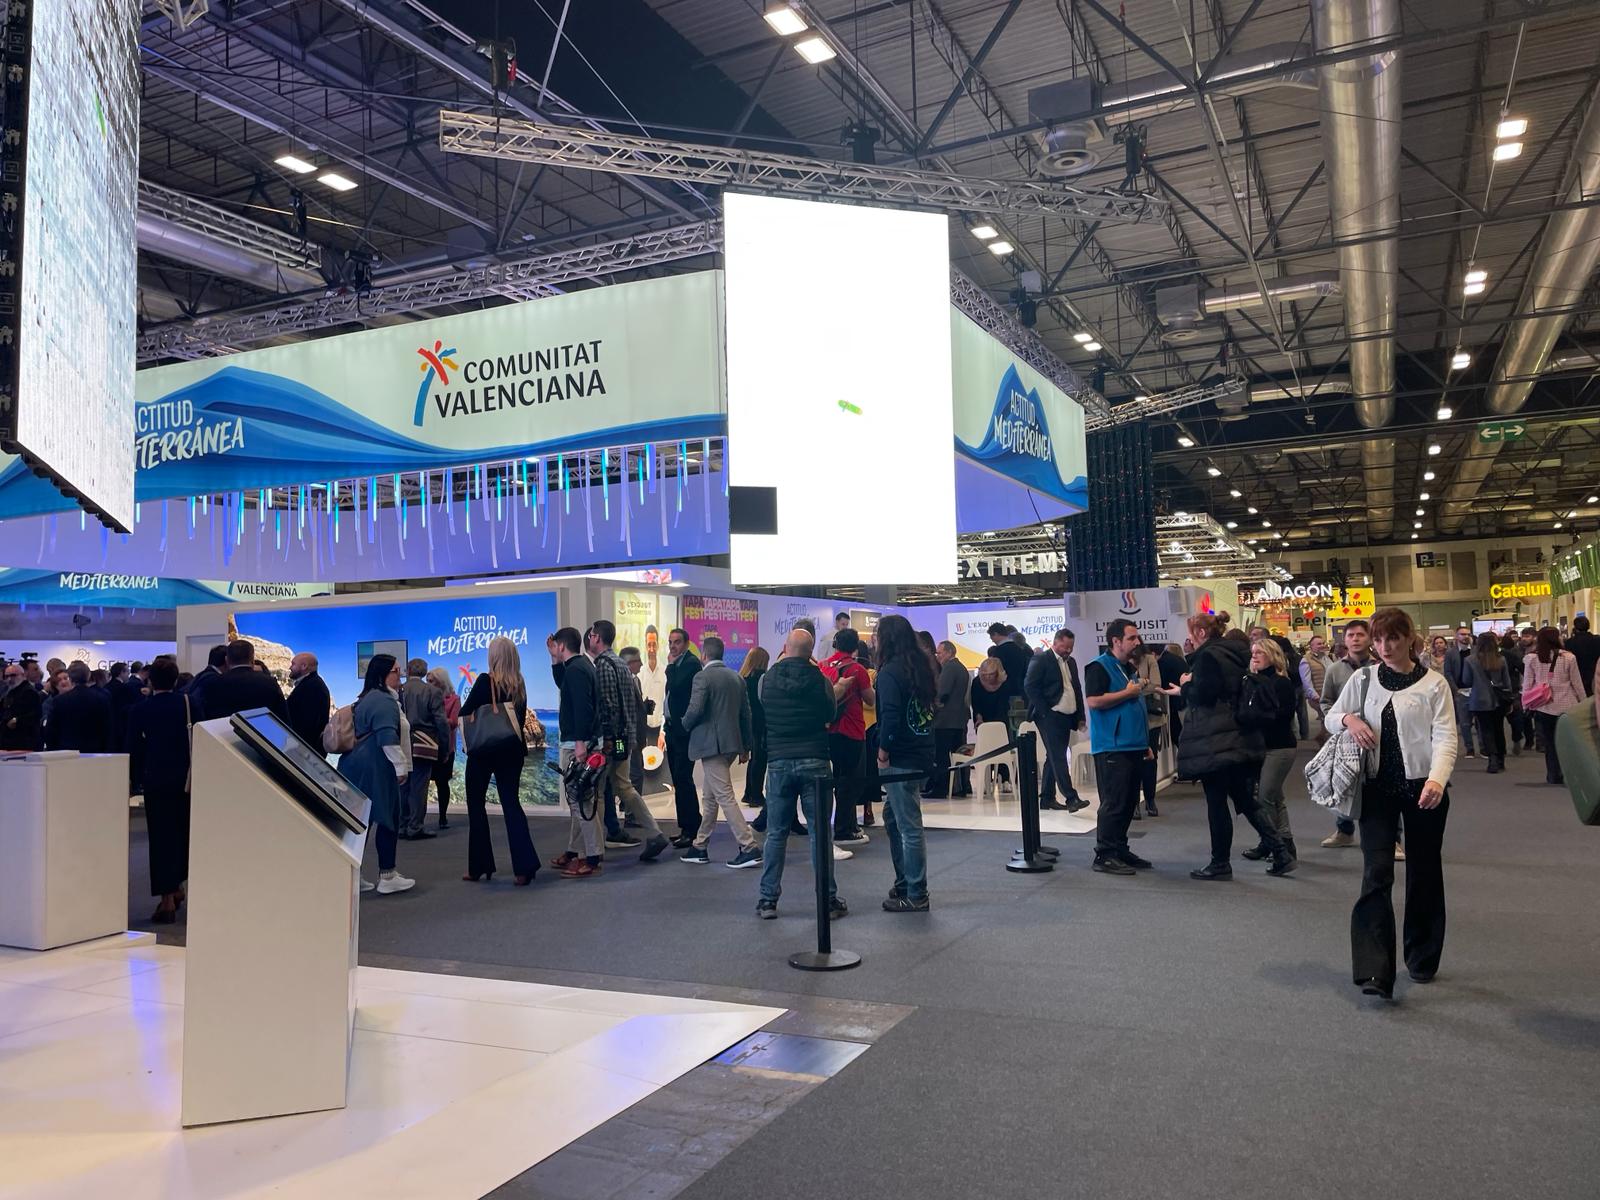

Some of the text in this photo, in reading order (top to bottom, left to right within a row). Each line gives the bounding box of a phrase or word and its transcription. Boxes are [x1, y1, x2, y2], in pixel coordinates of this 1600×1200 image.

[463, 340, 602, 383] COMUNITAT
[435, 369, 606, 418] VALENCIANA
[237, 584, 298, 597] VALENCIANA
[1258, 582, 1332, 600] AAGÓN
[454, 616, 497, 632] ACTITUD
[1036, 615, 1063, 624] ACTITUD
